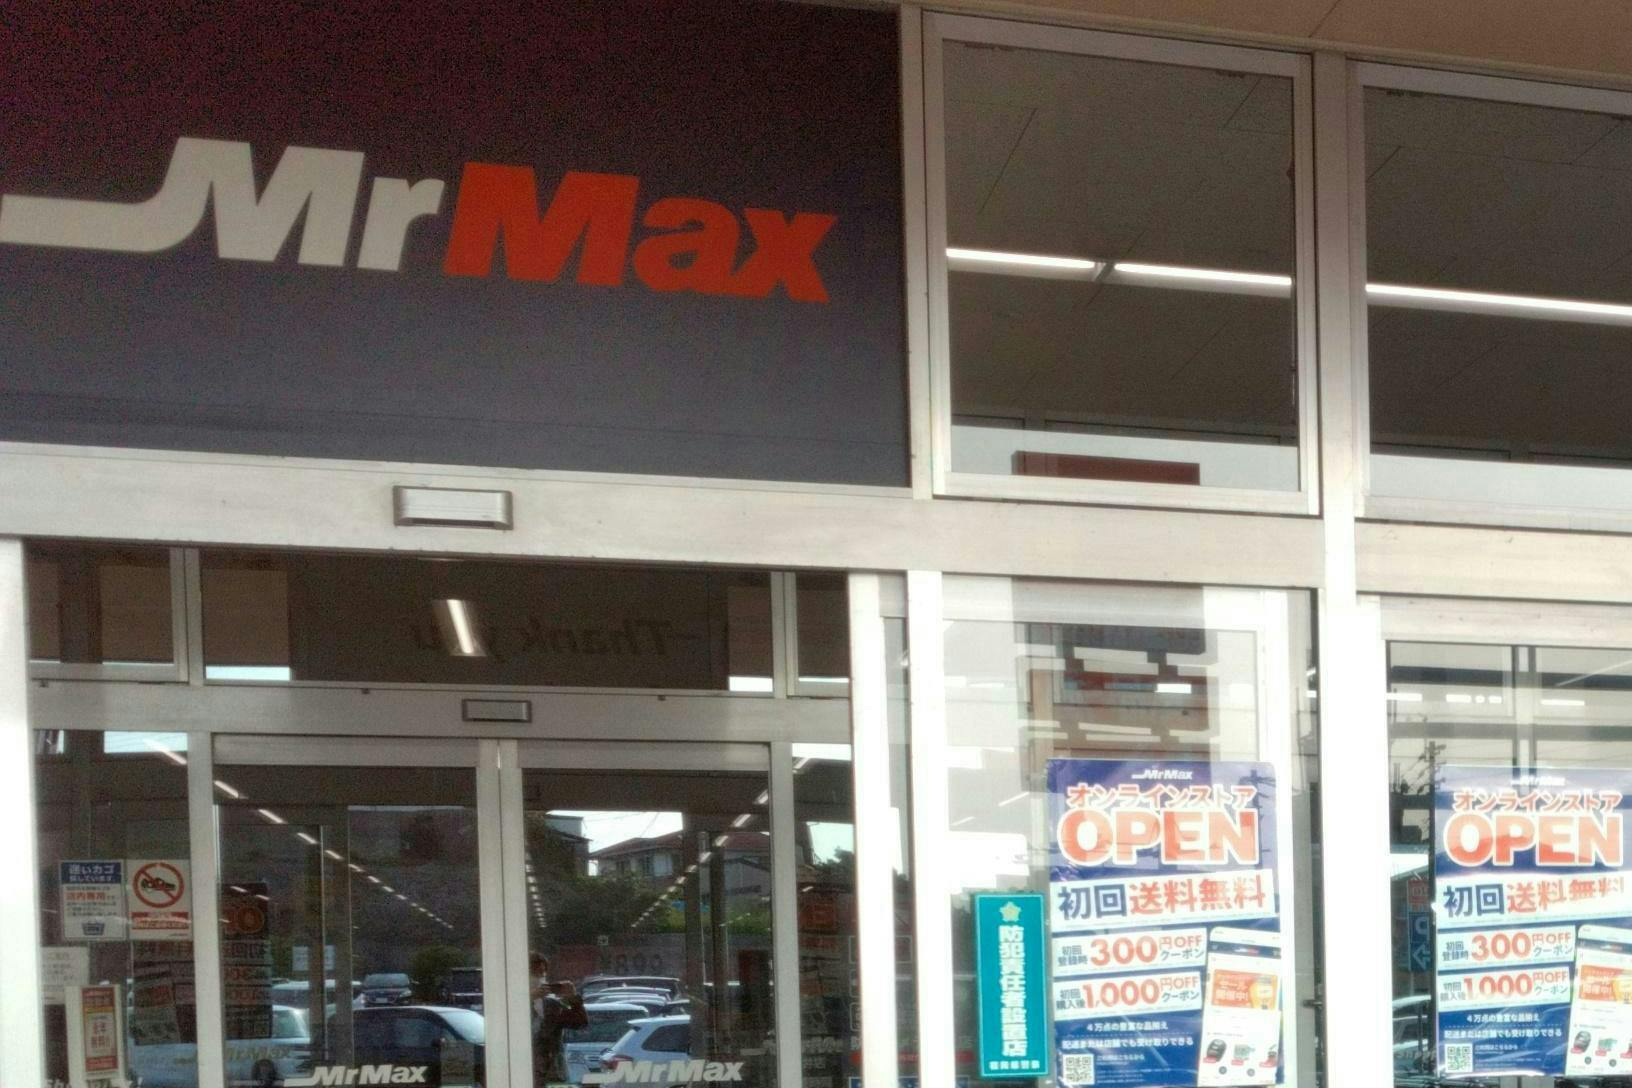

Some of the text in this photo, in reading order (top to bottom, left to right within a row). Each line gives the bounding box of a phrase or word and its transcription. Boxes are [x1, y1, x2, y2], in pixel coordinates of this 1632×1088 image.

[0, 136, 838, 303] MrMax
[1131, 769, 1193, 780] MrMax
[1066, 784, 1257, 809] オンラインストア
[1453, 789, 1624, 812] オンラインストア
[1057, 808, 1259, 866] OPEN
[1444, 812, 1624, 867] OPEN
[1058, 874, 1266, 921] 初回送料無料
[1090, 935, 1158, 966] 300
[1160, 948, 1205, 962] クーポン
[1471, 932, 1532, 961] 300
[1533, 945, 1573, 958] クーポン
[1082, 979, 1160, 1009] 1,000
[1161, 991, 1200, 1003] クーポン
[1535, 985, 1569, 996] クーポン
[284, 1064, 428, 1087] MrMax
[582, 1059, 745, 1083] MrMax
